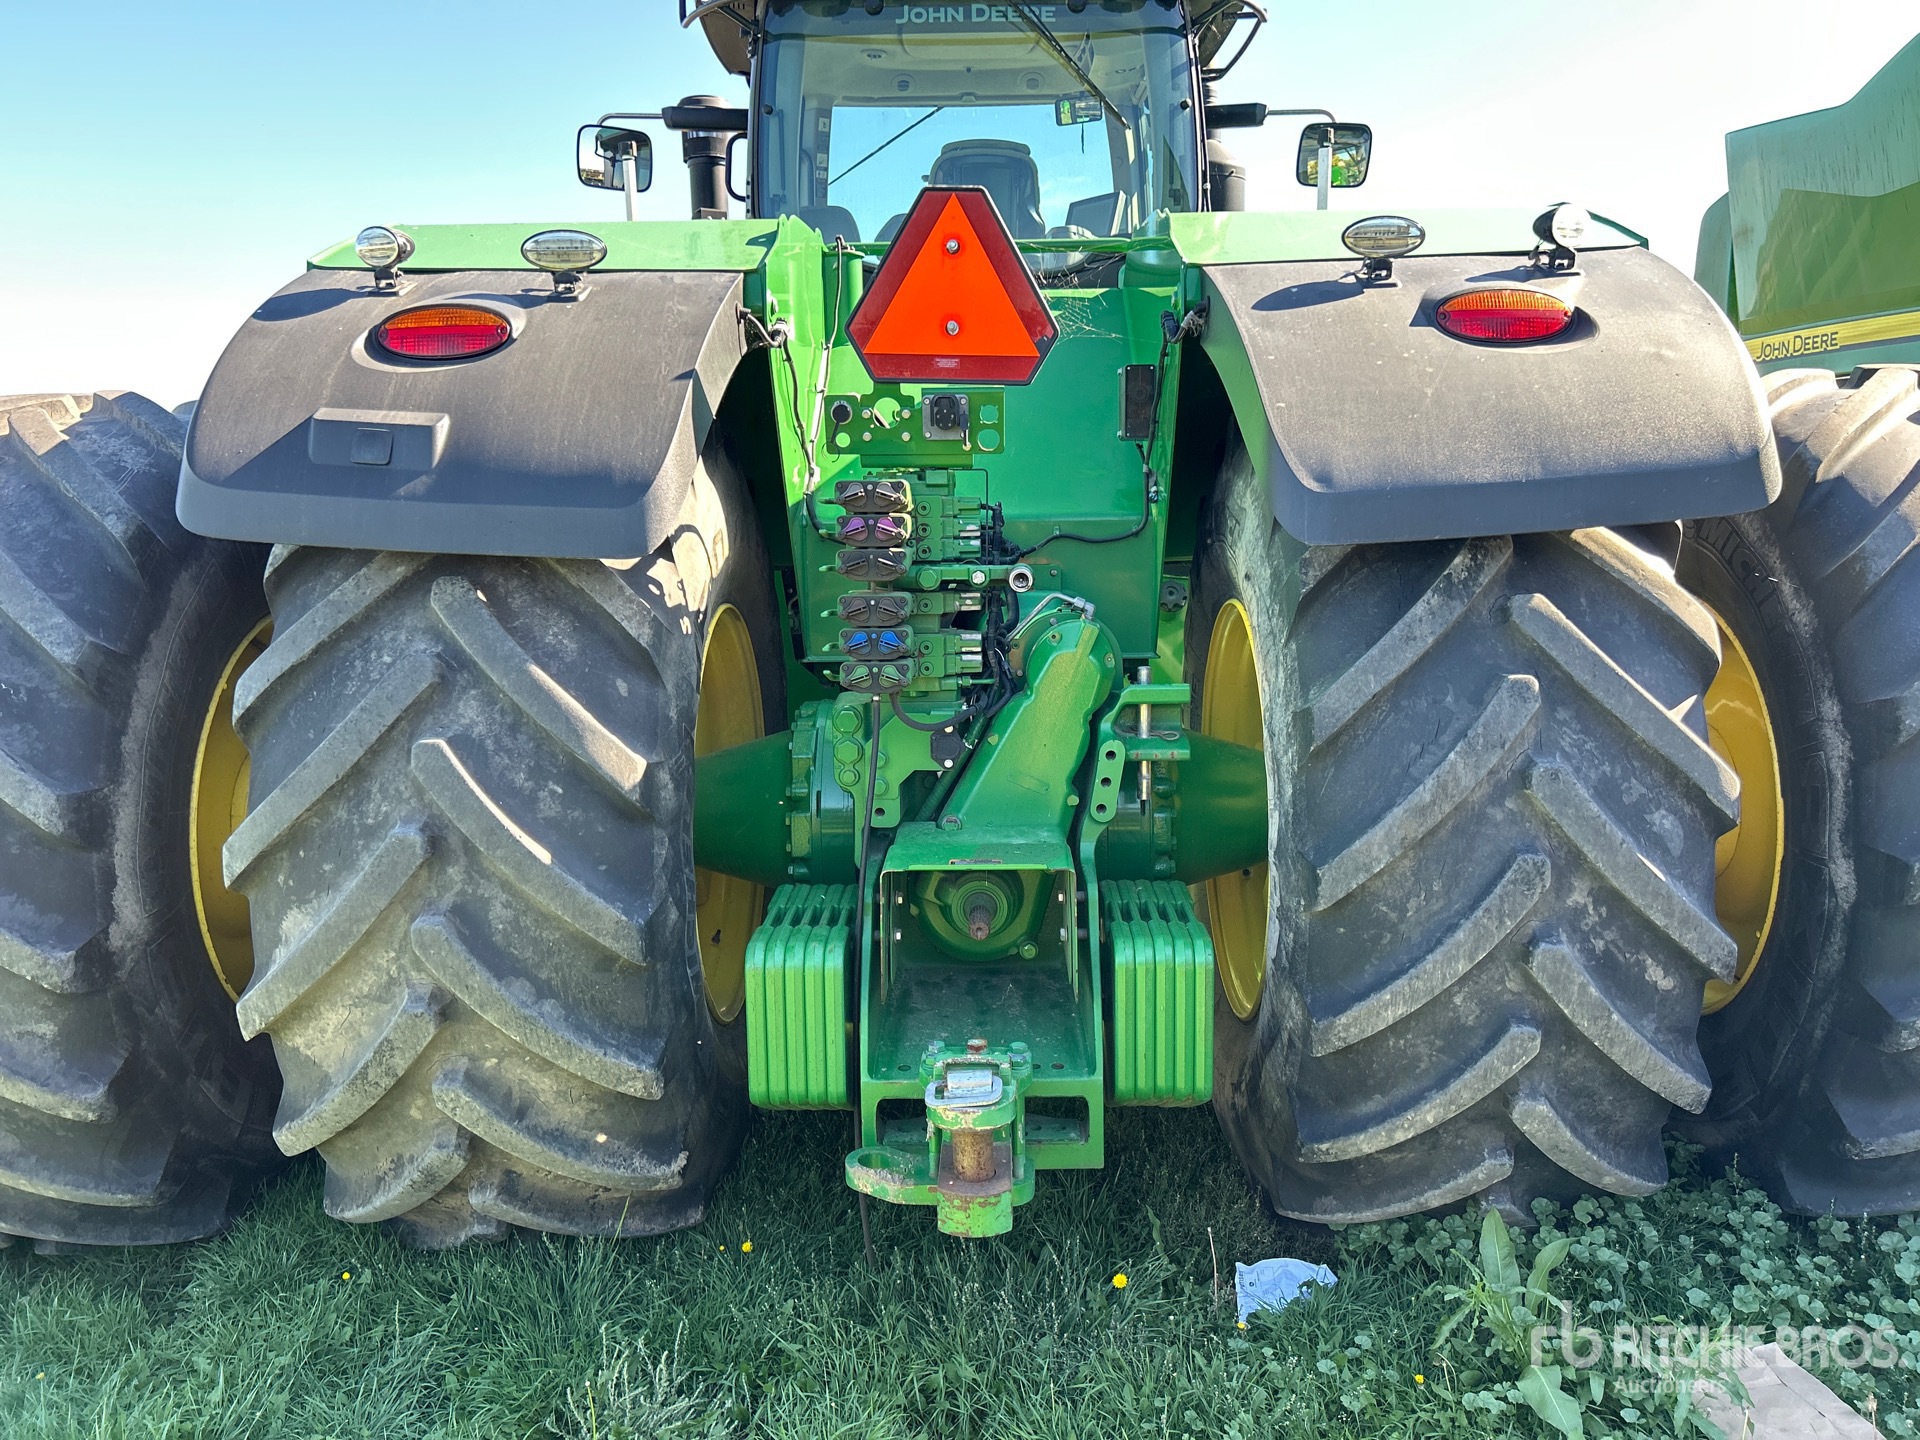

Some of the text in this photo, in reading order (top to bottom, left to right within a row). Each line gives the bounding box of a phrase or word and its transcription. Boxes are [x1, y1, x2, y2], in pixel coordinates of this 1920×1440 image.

[895, 5, 963, 24] JOHN
[1756, 332, 1839, 360] JOHN DEERE
